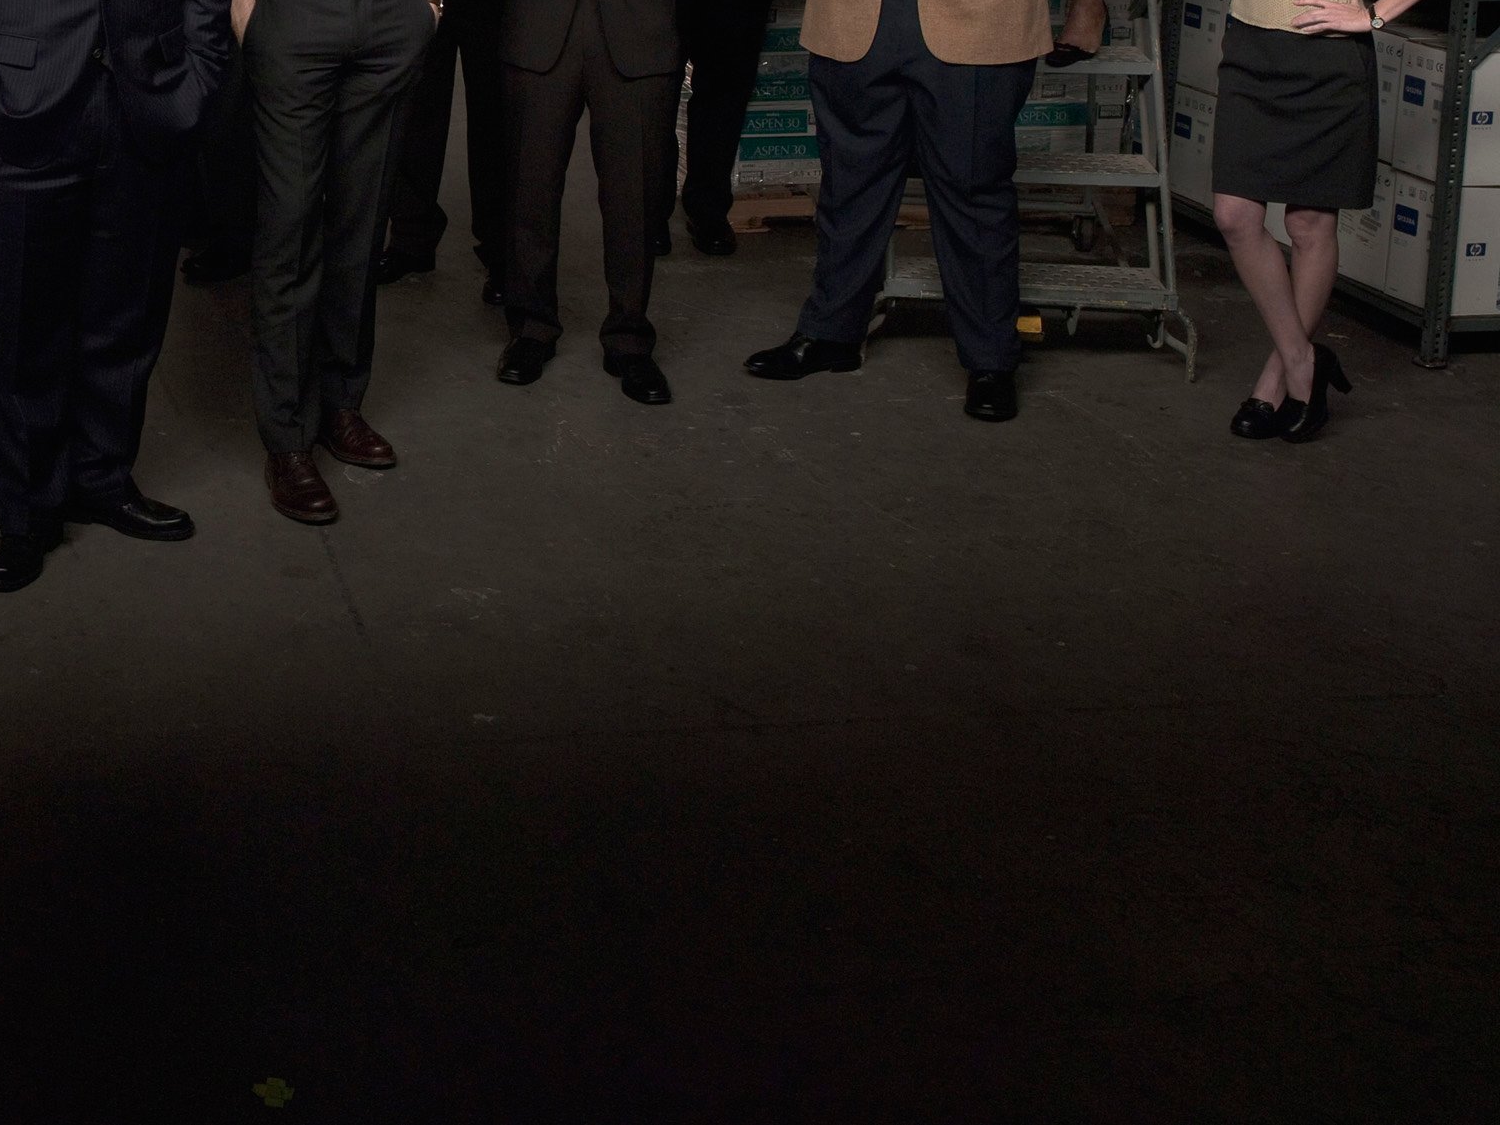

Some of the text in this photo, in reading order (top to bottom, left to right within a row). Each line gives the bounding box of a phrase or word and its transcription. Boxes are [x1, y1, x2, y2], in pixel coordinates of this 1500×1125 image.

[790, 85, 805, 96] 30
[1017, 110, 1067, 122] ASPEN 30
[747, 116, 801, 129] ASPEN 30
[753, 144, 807, 156] ASPEN 30
